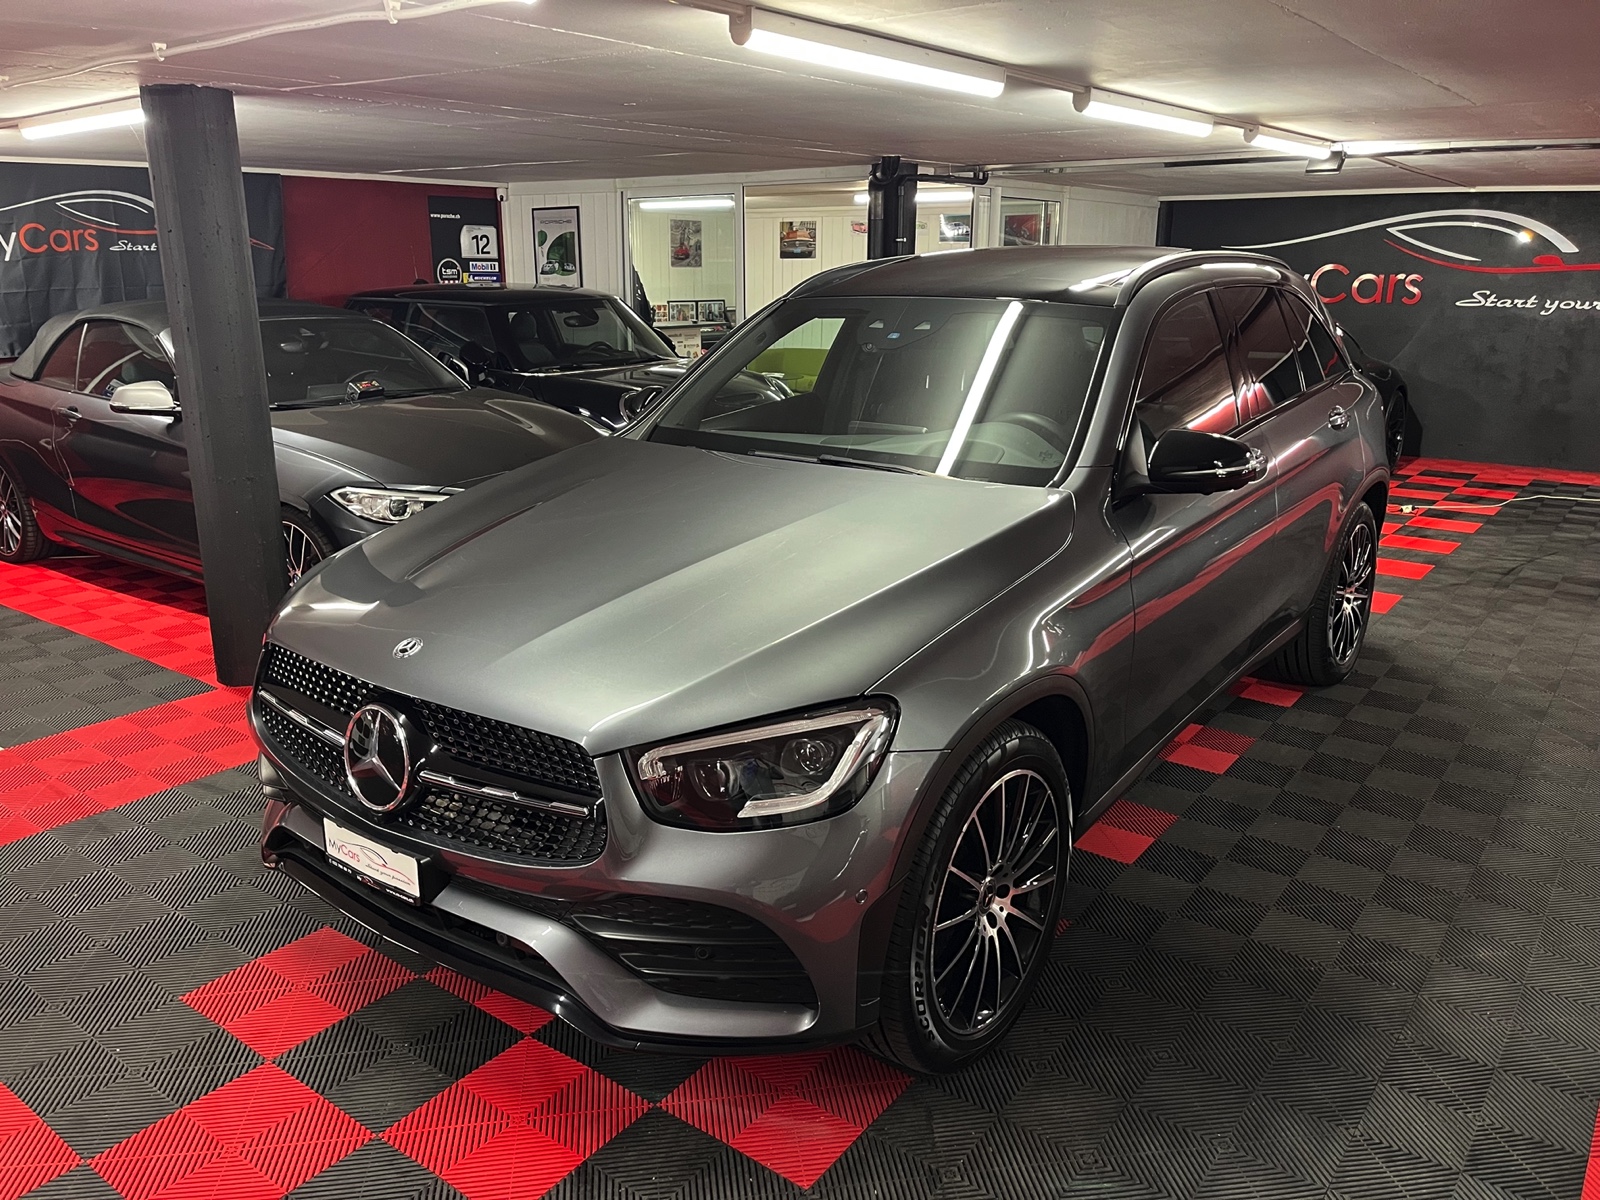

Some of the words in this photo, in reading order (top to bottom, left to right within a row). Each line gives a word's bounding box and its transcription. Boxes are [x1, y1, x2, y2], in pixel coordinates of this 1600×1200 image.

[109, 239, 158, 251] Start
[471, 234, 491, 255] 12
[471, 263, 489, 271] Mobil
[1303, 263, 1424, 305] Cars
[1455, 290, 1538, 308] Start
[328, 837, 361, 863] MyCars
[914, 903, 936, 1042] SCORPION
